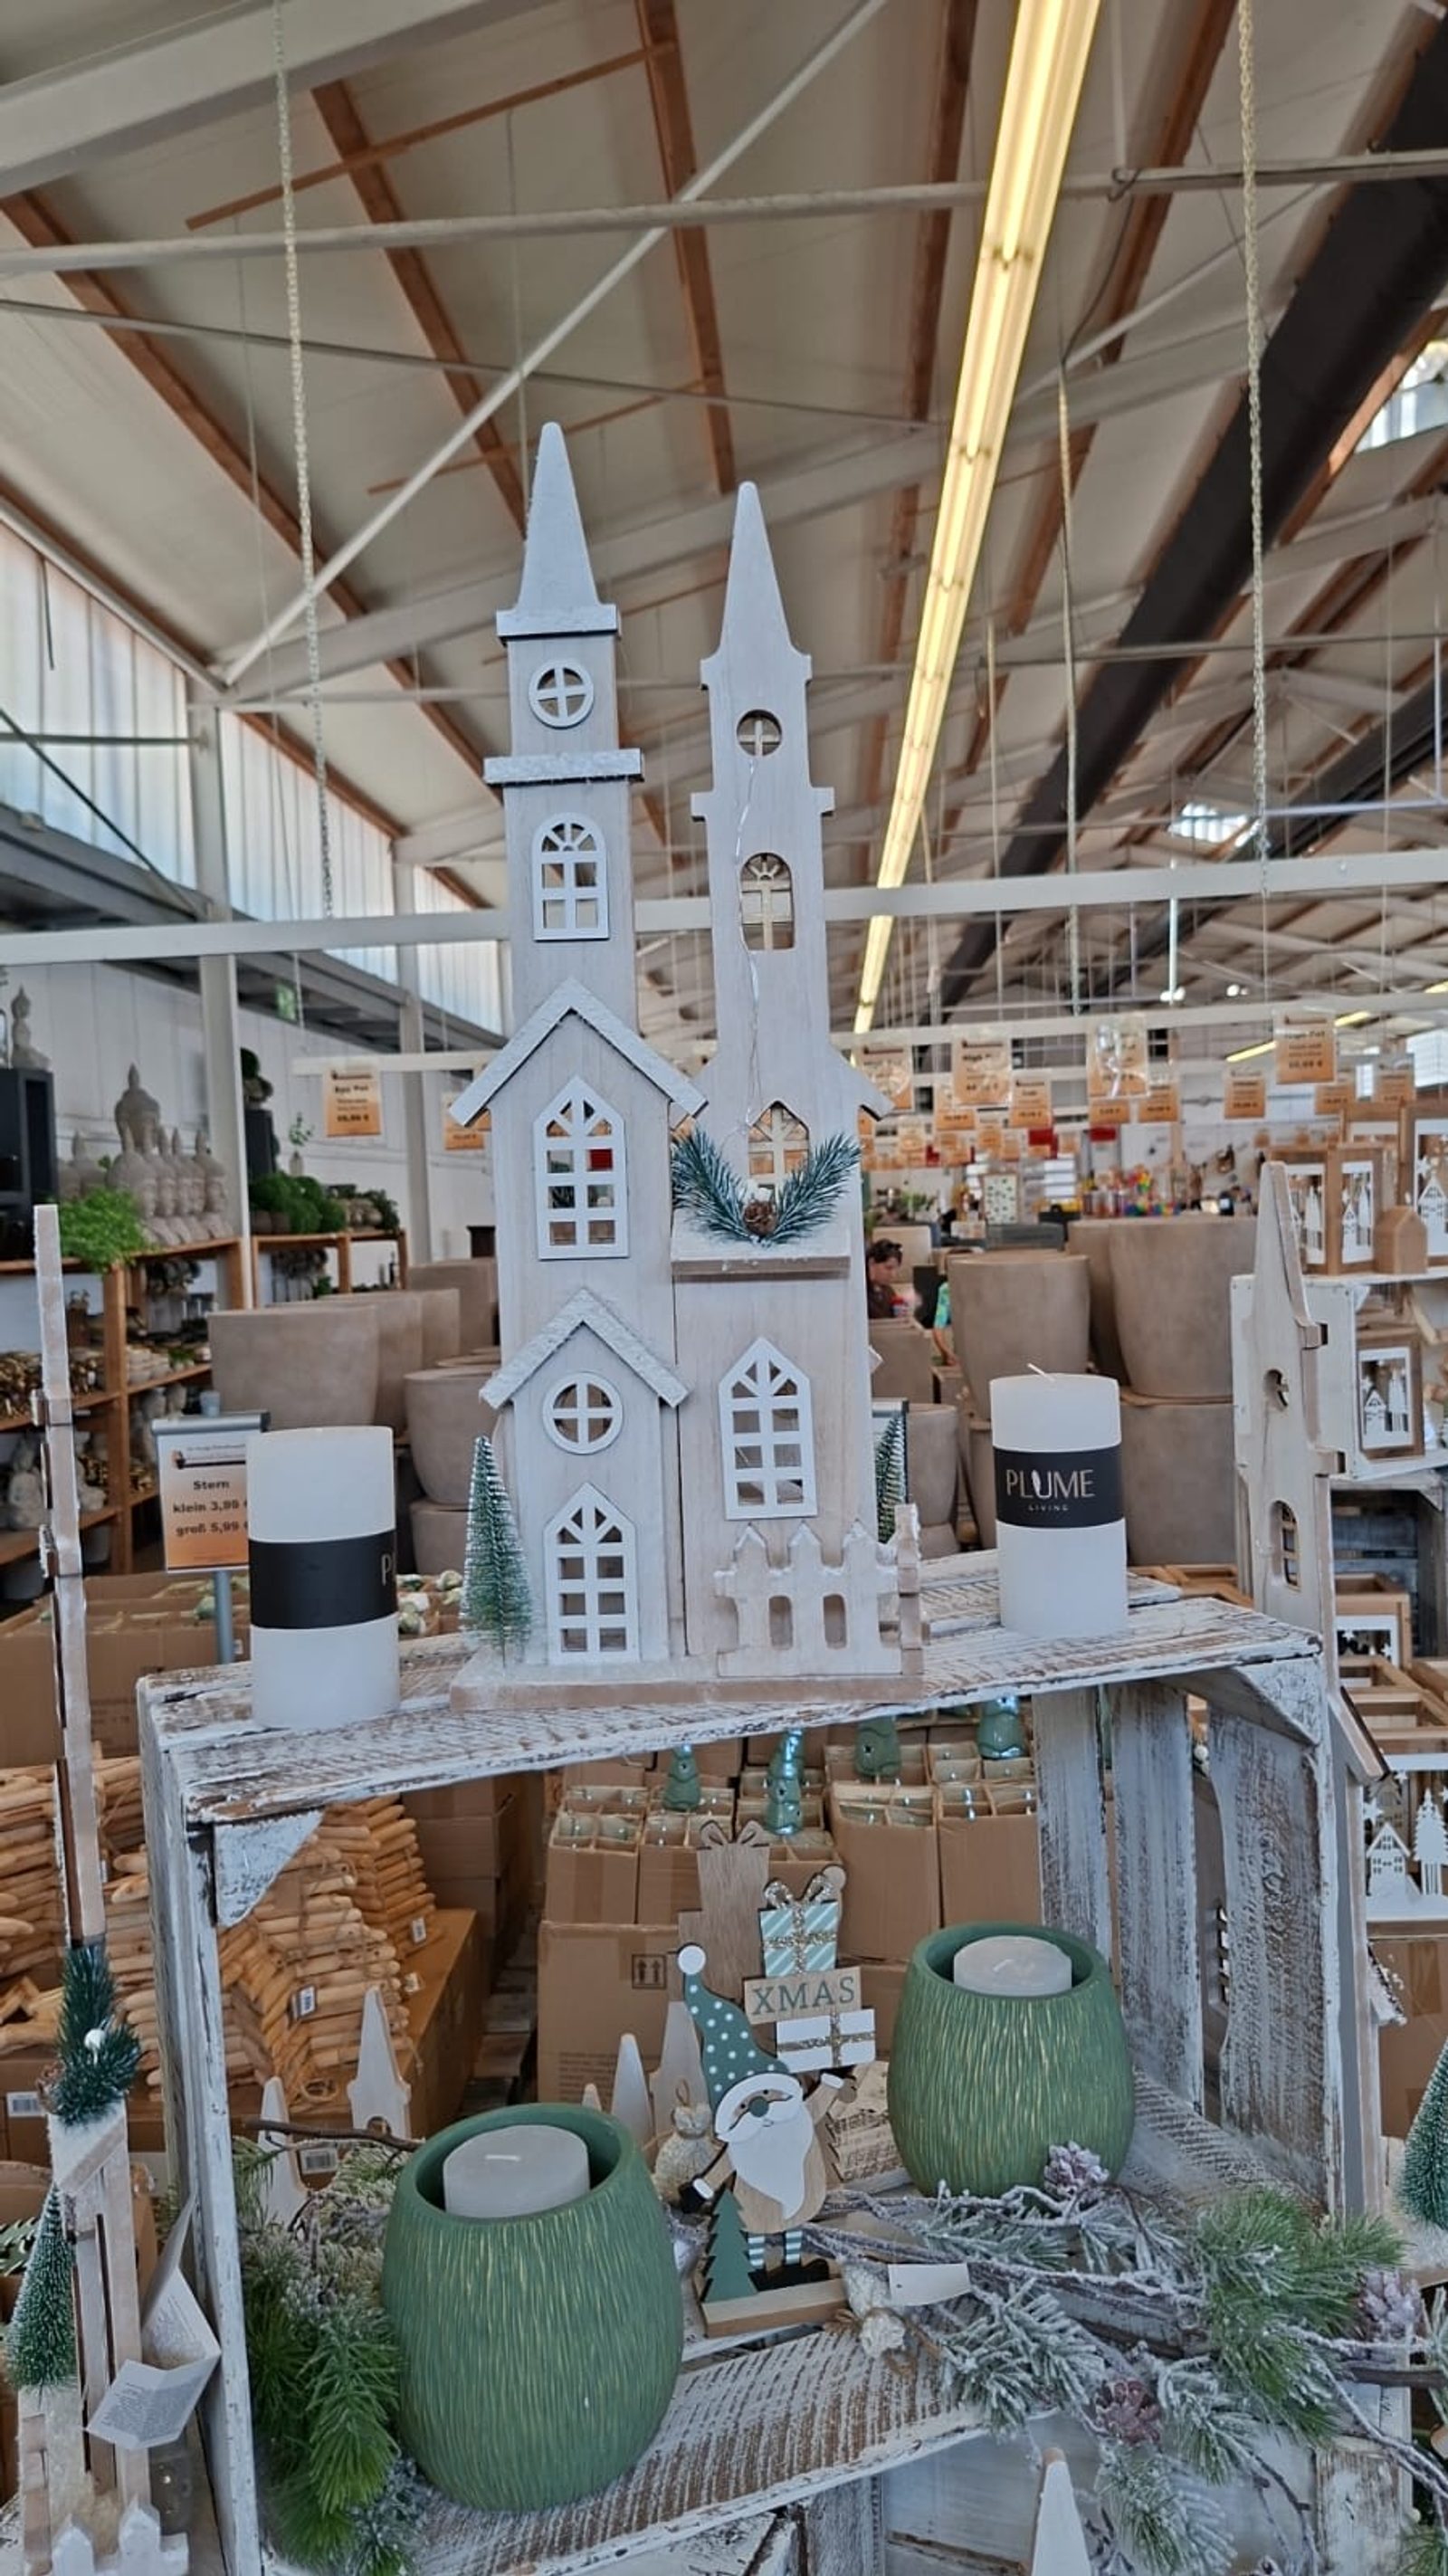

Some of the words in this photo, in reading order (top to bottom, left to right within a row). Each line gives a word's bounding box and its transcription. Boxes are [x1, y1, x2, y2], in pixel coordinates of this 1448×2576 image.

[194, 1481, 230, 1491] Stern
[1006, 1469, 1096, 1499] PLUME
[173, 1503, 206, 1513] klein
[211, 1521, 240, 1535] 5,99
[752, 1976, 855, 2016] XMAS
